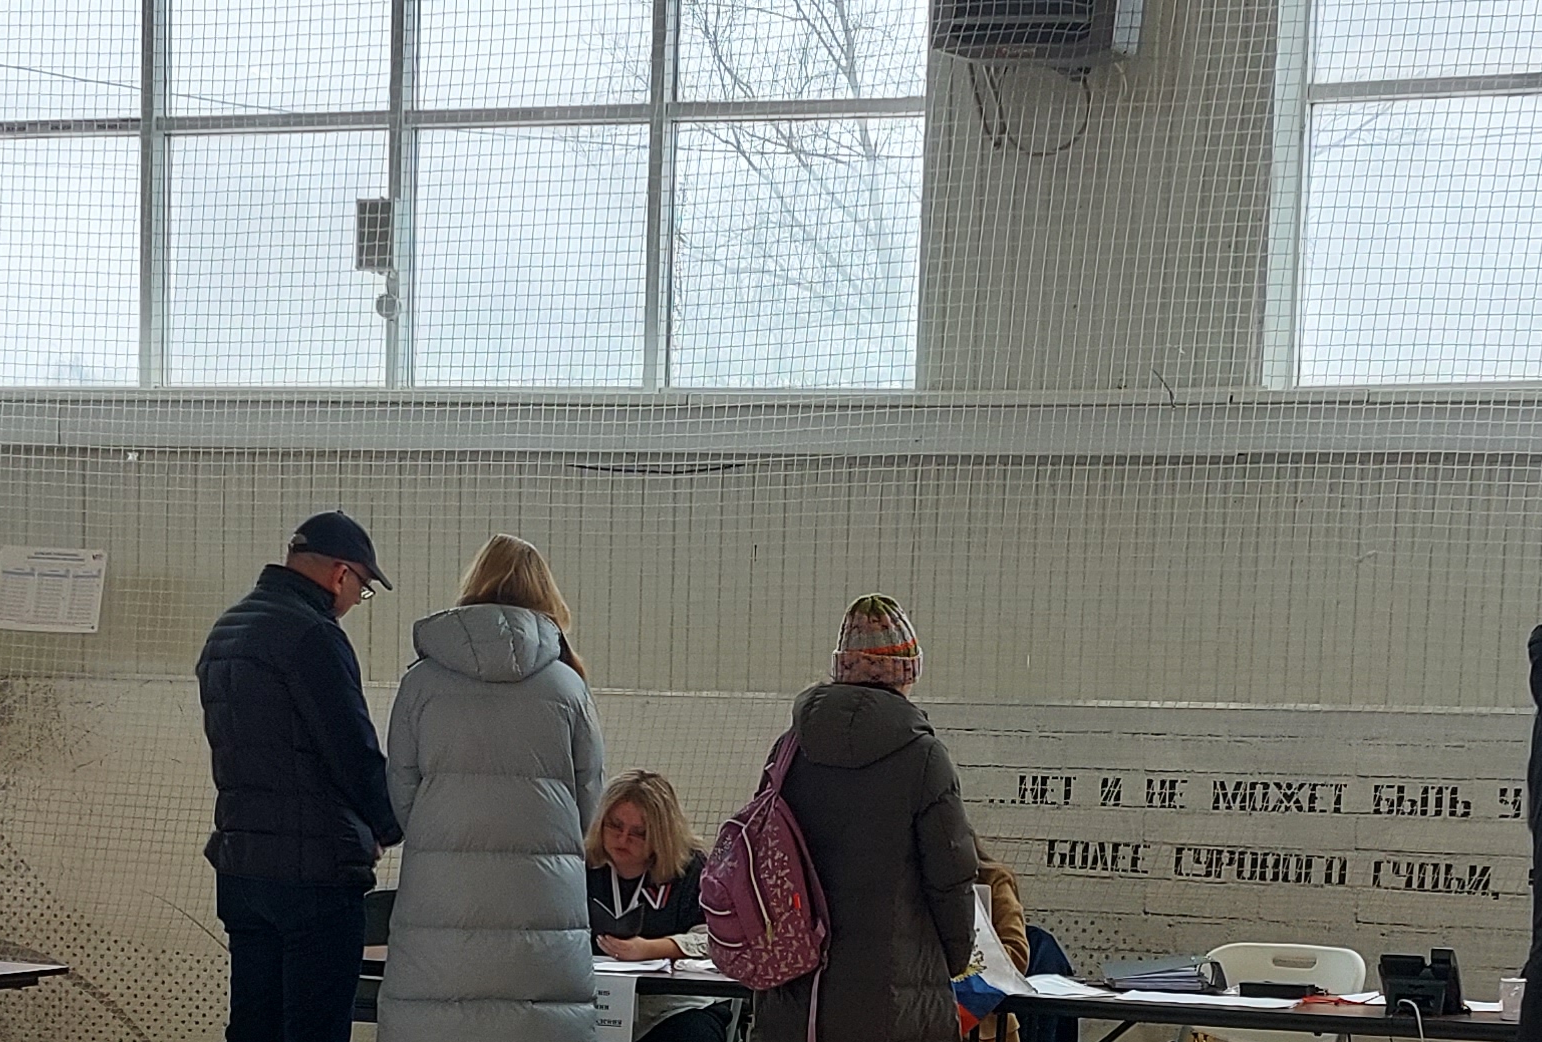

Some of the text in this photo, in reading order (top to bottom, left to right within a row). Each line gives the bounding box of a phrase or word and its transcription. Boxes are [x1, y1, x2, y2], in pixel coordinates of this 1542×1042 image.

[1145, 778, 1188, 810] НЕ
[1211, 780, 1347, 814] МОЖЕТ
[1047, 838, 1151, 874] БОЛЕЕ
[1173, 846, 1347, 887] СУРОВОГО
